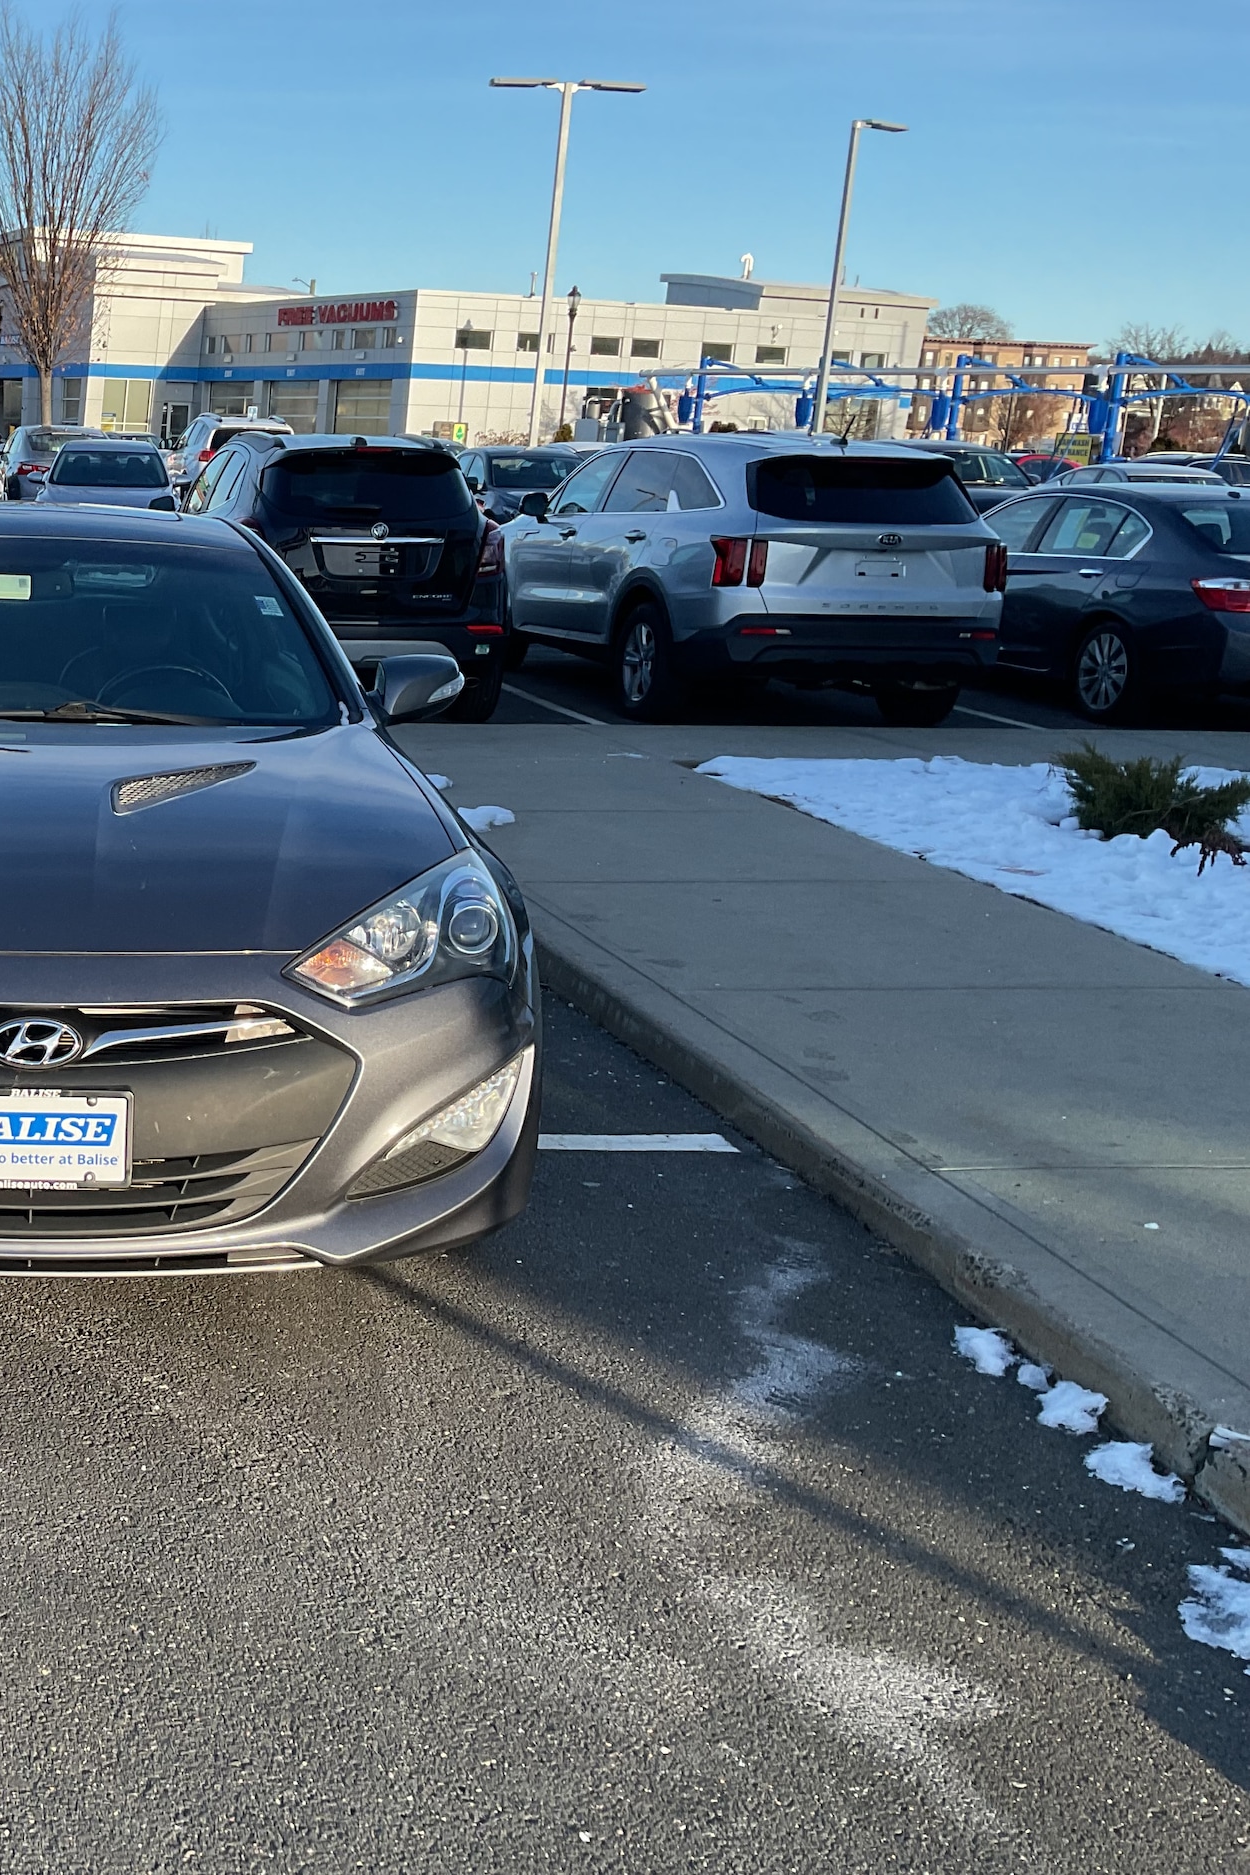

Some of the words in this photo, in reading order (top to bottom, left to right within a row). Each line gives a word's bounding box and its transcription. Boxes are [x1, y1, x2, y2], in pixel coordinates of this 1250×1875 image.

[278, 306, 317, 326] FREE
[318, 301, 399, 323] VACUUMS
[882, 535, 901, 544] KIA
[10, 1089, 62, 1098] BALISE
[11, 1152, 54, 1164] better
[58, 1154, 73, 1165] at
[77, 1153, 118, 1166] Balise
